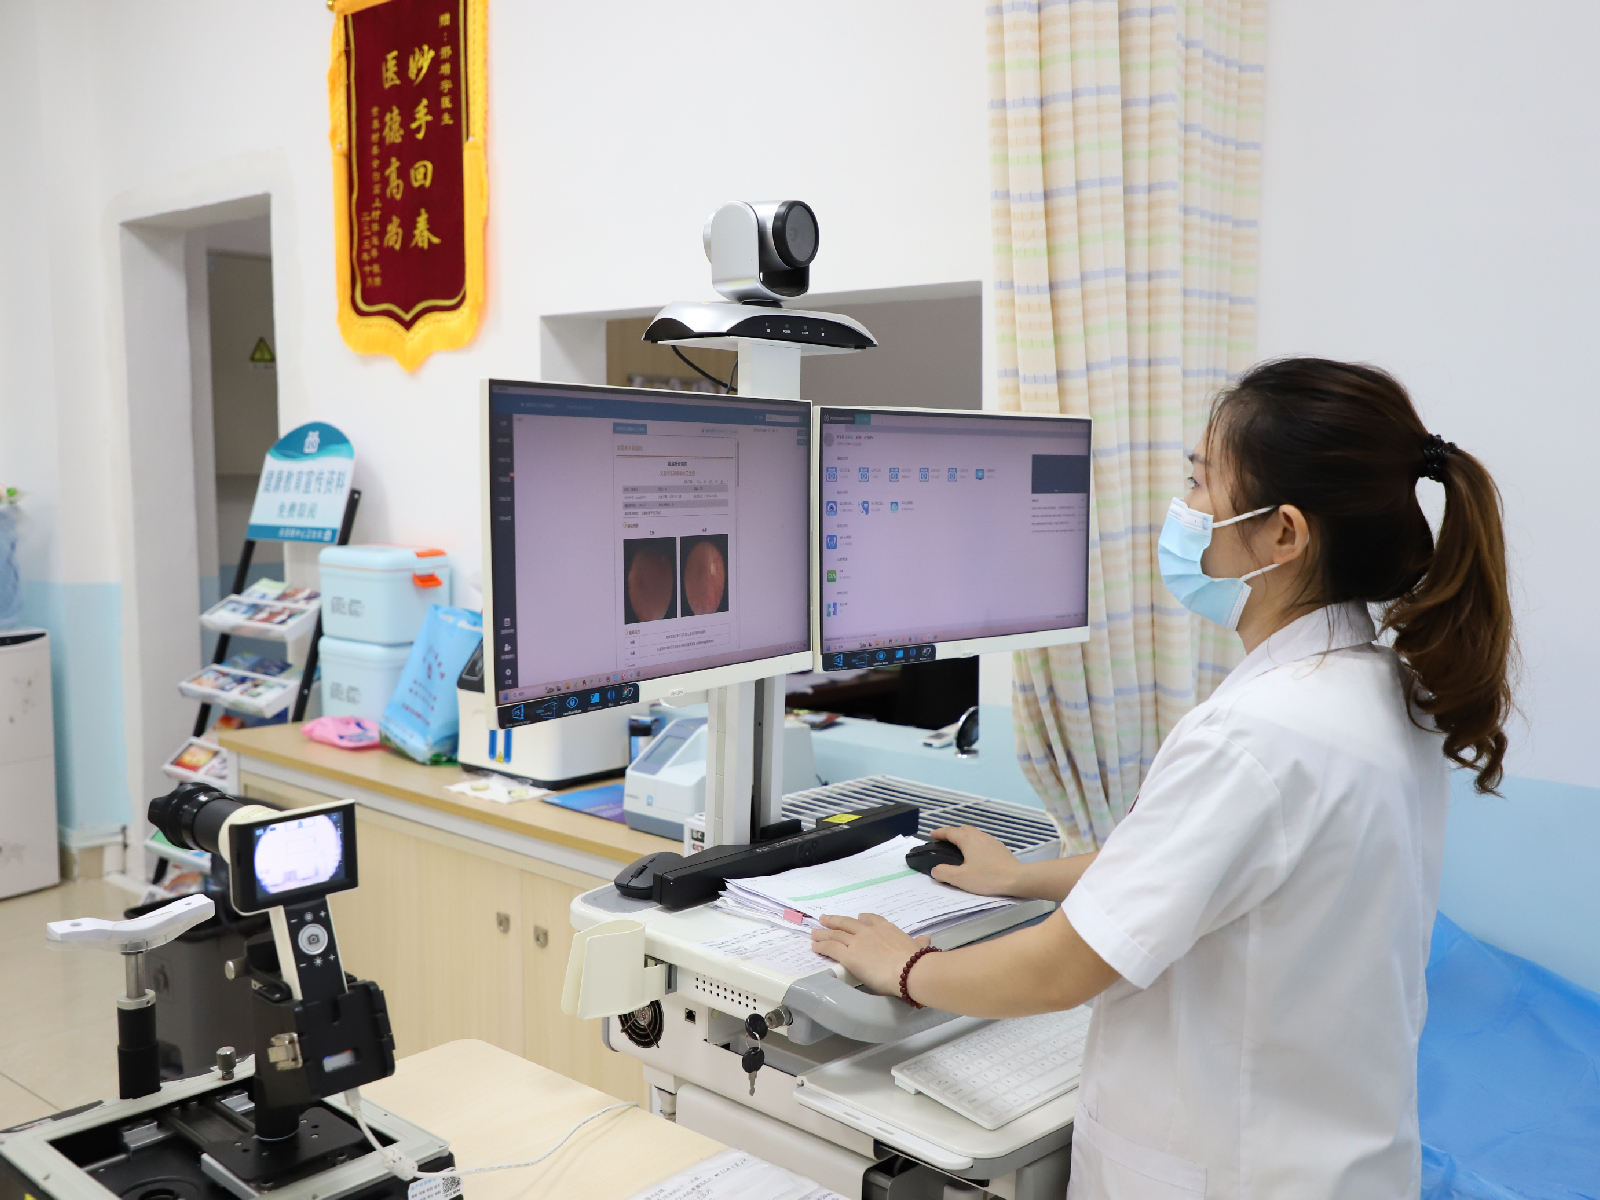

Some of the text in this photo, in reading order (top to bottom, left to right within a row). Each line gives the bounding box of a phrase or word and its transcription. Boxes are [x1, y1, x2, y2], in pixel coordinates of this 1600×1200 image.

[382, 49, 405, 252] 医德高尚
[407, 43, 441, 250] 妙手回春
[263, 469, 347, 495] 健康教育宣传资料
[277, 501, 319, 519] 免费取阅
